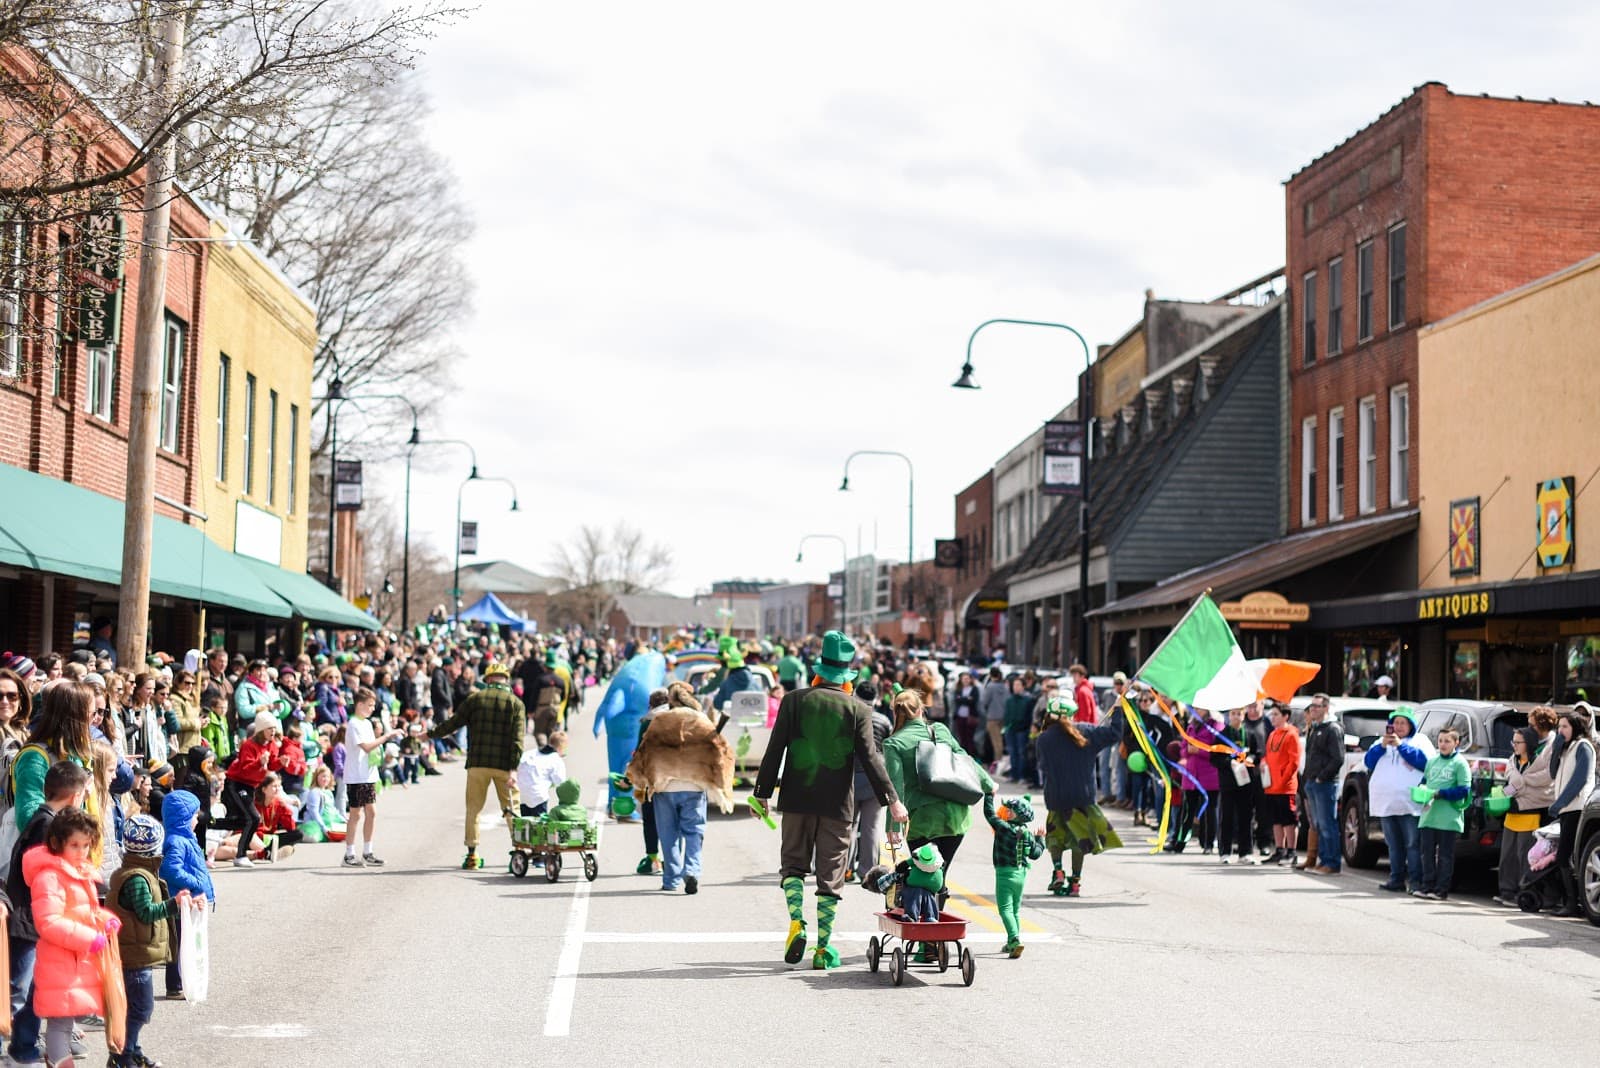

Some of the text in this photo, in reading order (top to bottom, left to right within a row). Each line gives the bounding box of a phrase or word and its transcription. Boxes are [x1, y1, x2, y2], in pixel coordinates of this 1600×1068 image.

[83, 270, 113, 292] GENERAL
[88, 288, 106, 340] STORE
[1419, 592, 1489, 619] ANTIQUES
